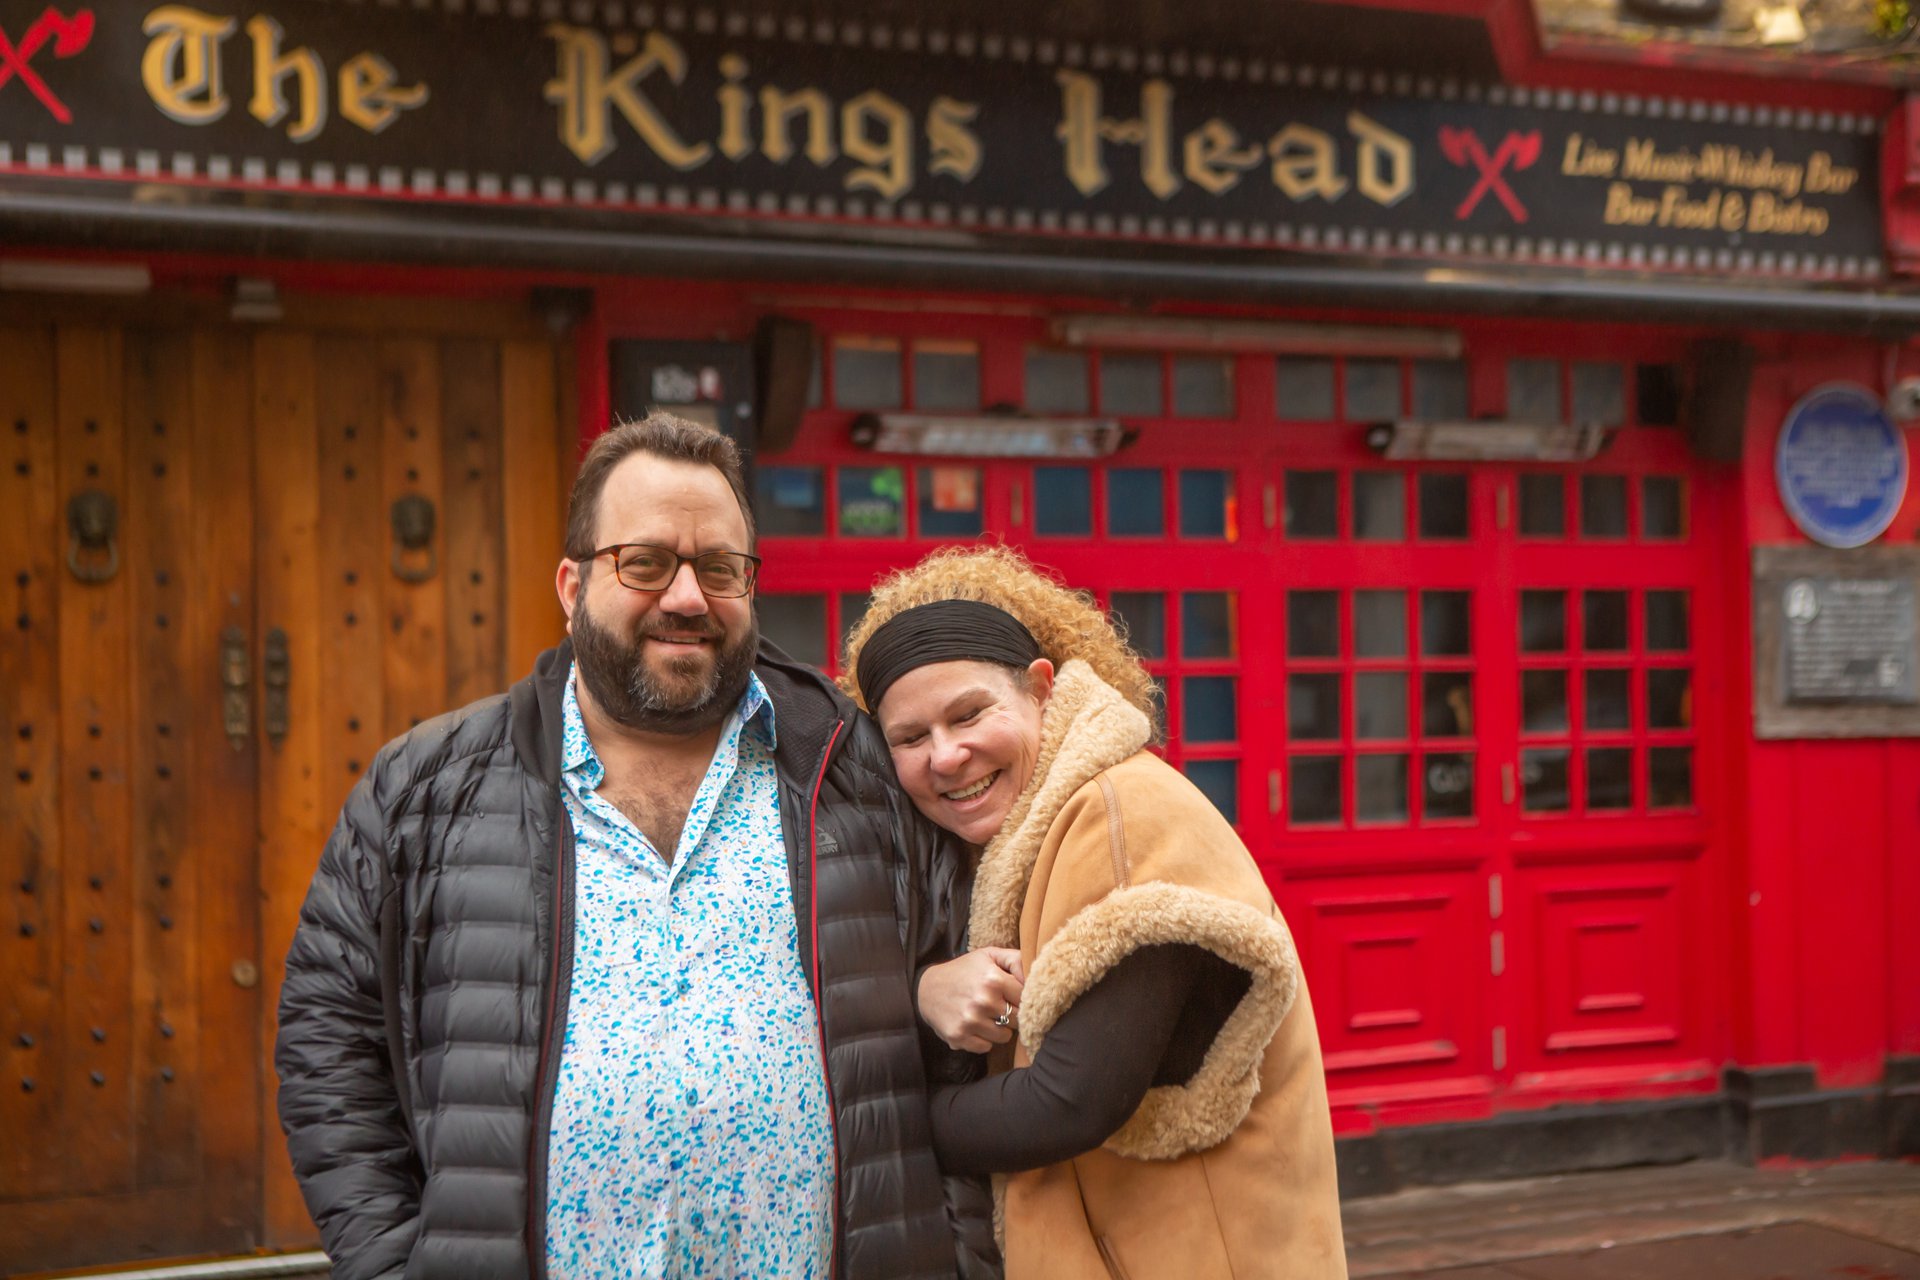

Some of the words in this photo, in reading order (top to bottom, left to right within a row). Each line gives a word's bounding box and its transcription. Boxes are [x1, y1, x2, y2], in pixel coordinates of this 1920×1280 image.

[141, 5, 428, 143] The
[544, 22, 985, 201] Kings
[1056, 68, 1416, 206] Head
